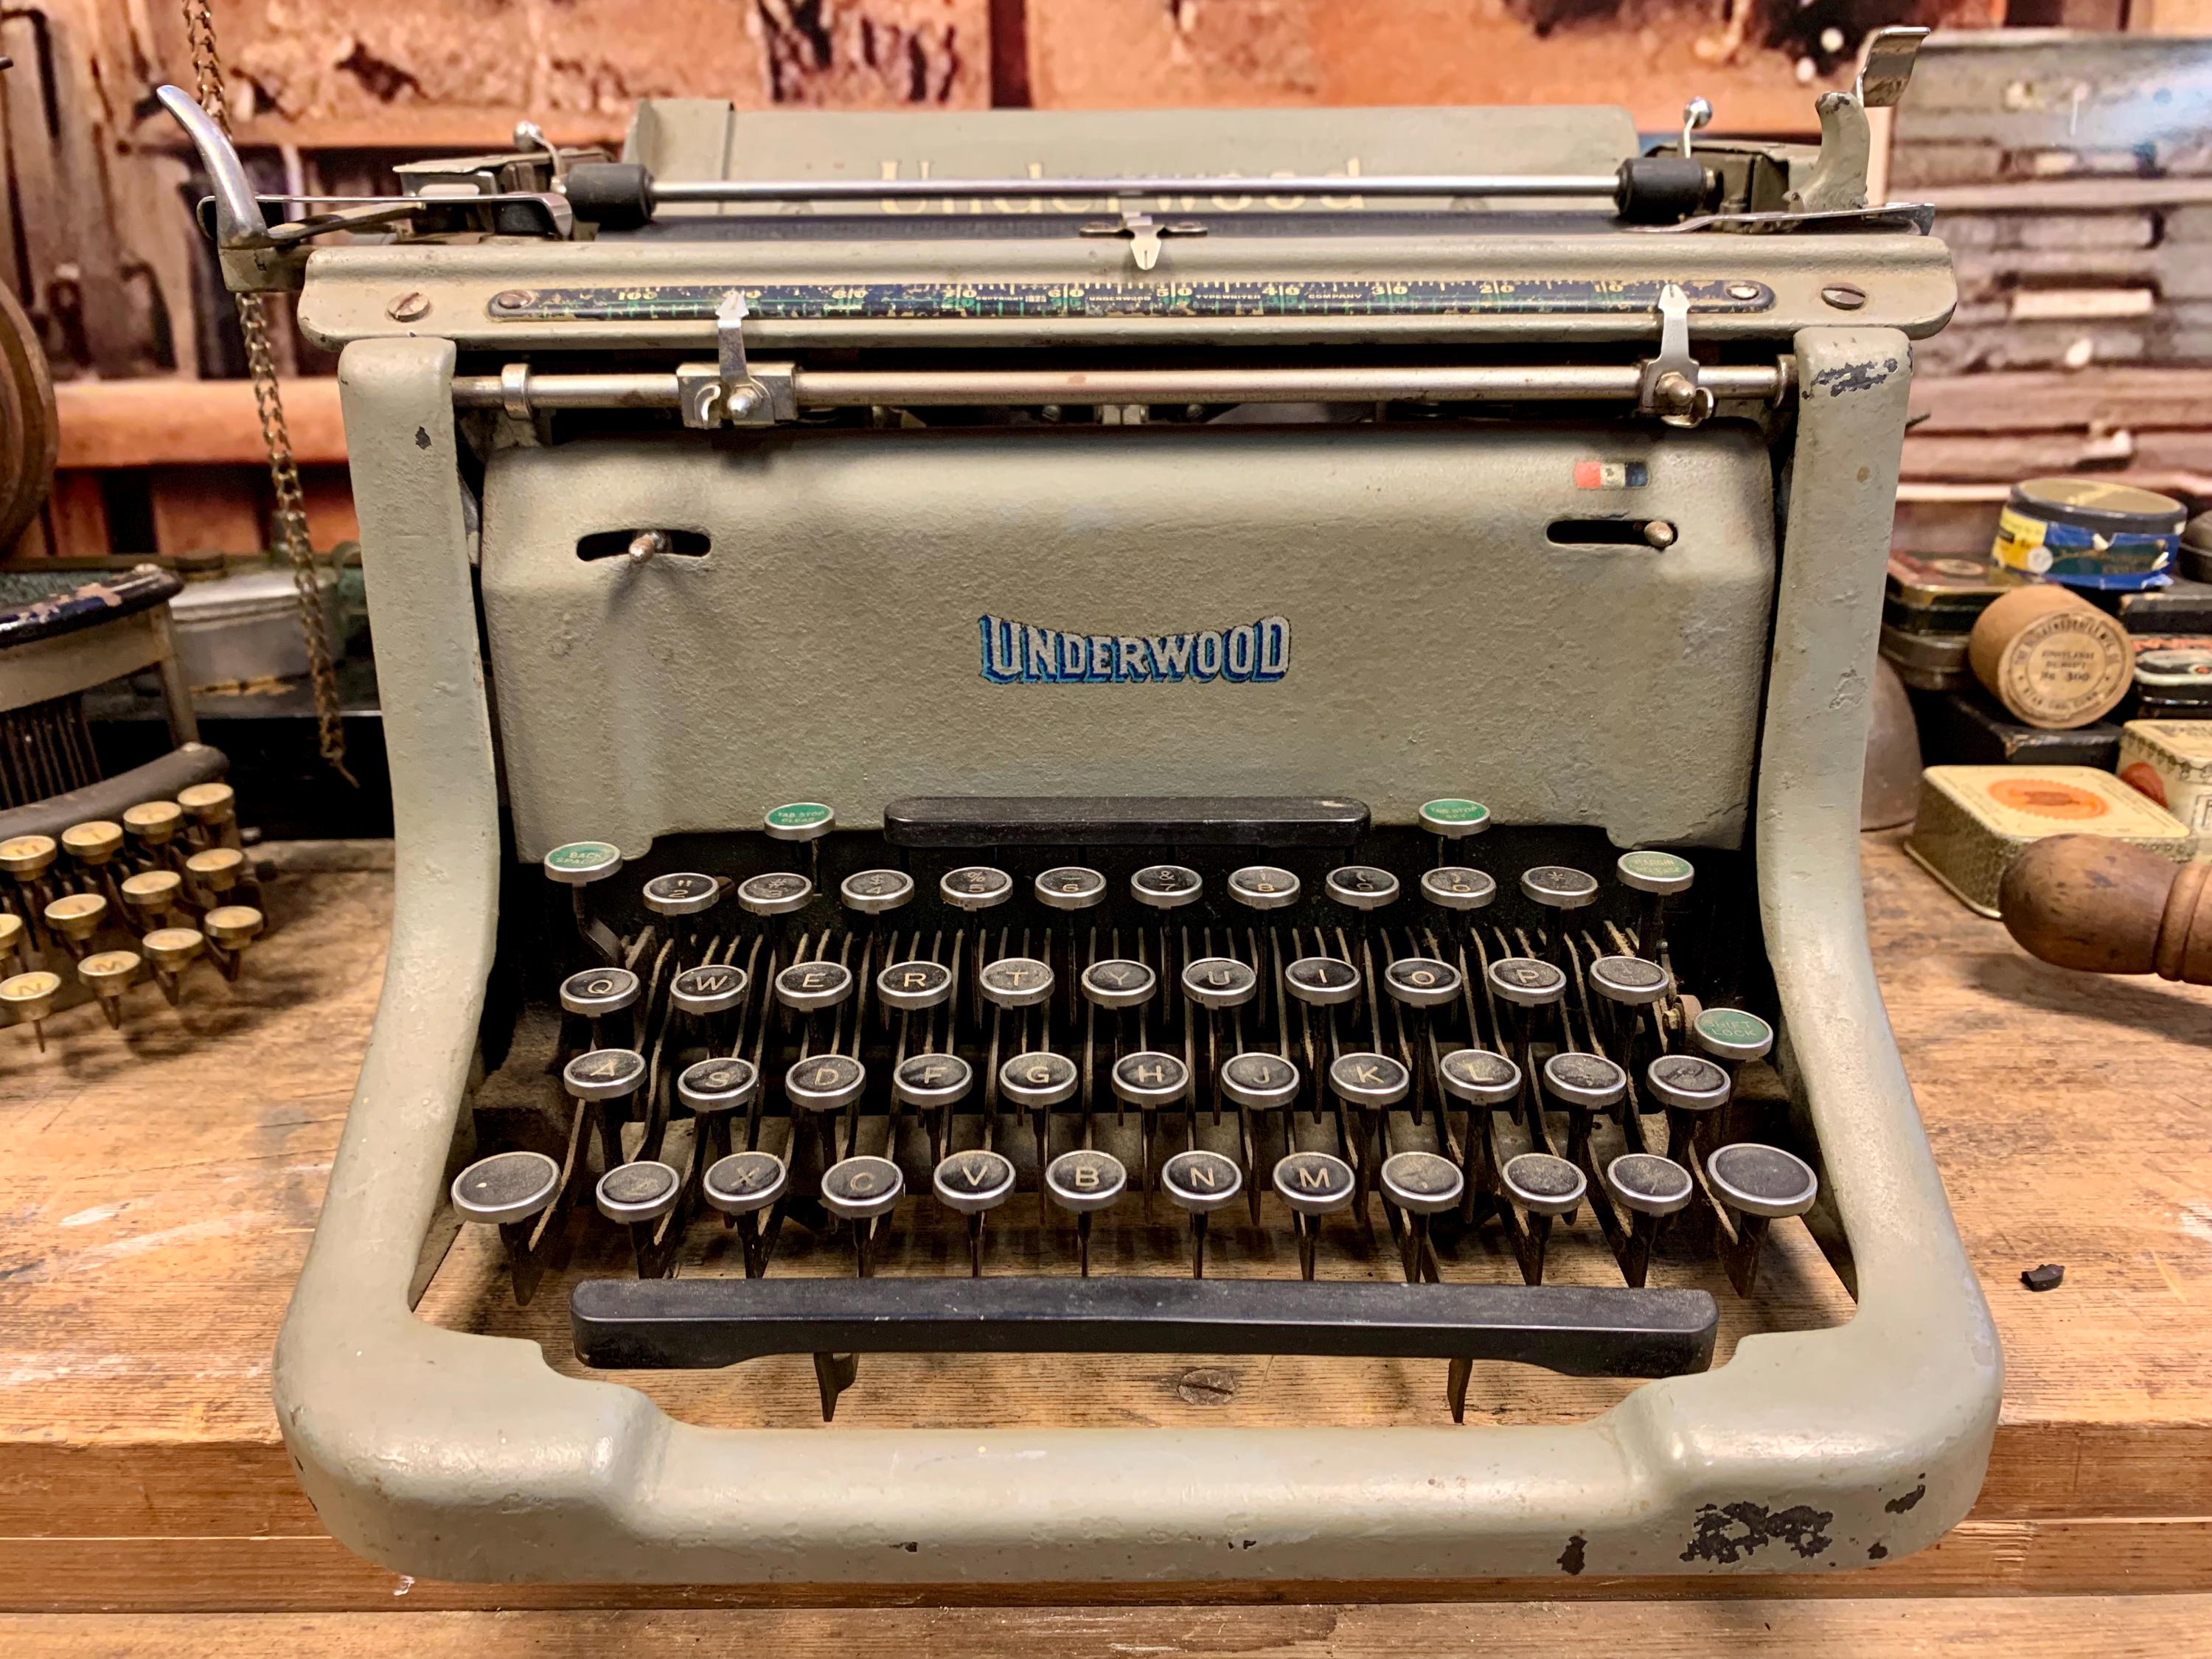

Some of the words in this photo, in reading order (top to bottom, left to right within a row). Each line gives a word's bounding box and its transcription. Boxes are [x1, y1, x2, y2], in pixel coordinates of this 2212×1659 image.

[1048, 289, 1085, 297] 60
[1156, 288, 1193, 296] 50
[1262, 288, 1301, 296] 40
[1371, 286, 1408, 295] 30
[1480, 285, 1515, 293] 20
[978, 613, 1291, 684] UNDERWOOD
[869, 875, 883, 886] $
[967, 872, 986, 882] %
[1158, 871, 1175, 880] &
[668, 889, 689, 898] 2
[866, 886, 881, 894] 4
[968, 884, 986, 893] 5
[1062, 883, 1079, 892] 6
[1257, 883, 1274, 891] 8
[695, 974, 728, 991] W
[801, 973, 827, 988] E
[903, 972, 926, 987] R
[1006, 971, 1029, 986] T
[1108, 971, 1130, 986] Y
[1208, 970, 1231, 986] U
[1318, 969, 1327, 984] I
[1411, 970, 1436, 985] O
[1516, 969, 1540, 984] P
[587, 979, 613, 995] Q
[1711, 1028, 1757, 1037] LOCK
[814, 1068, 839, 1086] D
[923, 1066, 947, 1084] F
[1026, 1065, 1049, 1084] G
[1138, 1065, 1163, 1082] H
[1252, 1066, 1270, 1084] J
[1356, 1065, 1384, 1084] K
[1466, 1062, 1495, 1081] L
[706, 1071, 730, 1088] S
[731, 1166, 761, 1187] X
[849, 1172, 874, 1192] C
[961, 1165, 989, 1186] V
[1075, 1166, 1100, 1187] B
[1189, 1166, 1215, 1187] N
[1299, 1166, 1331, 1188] M
